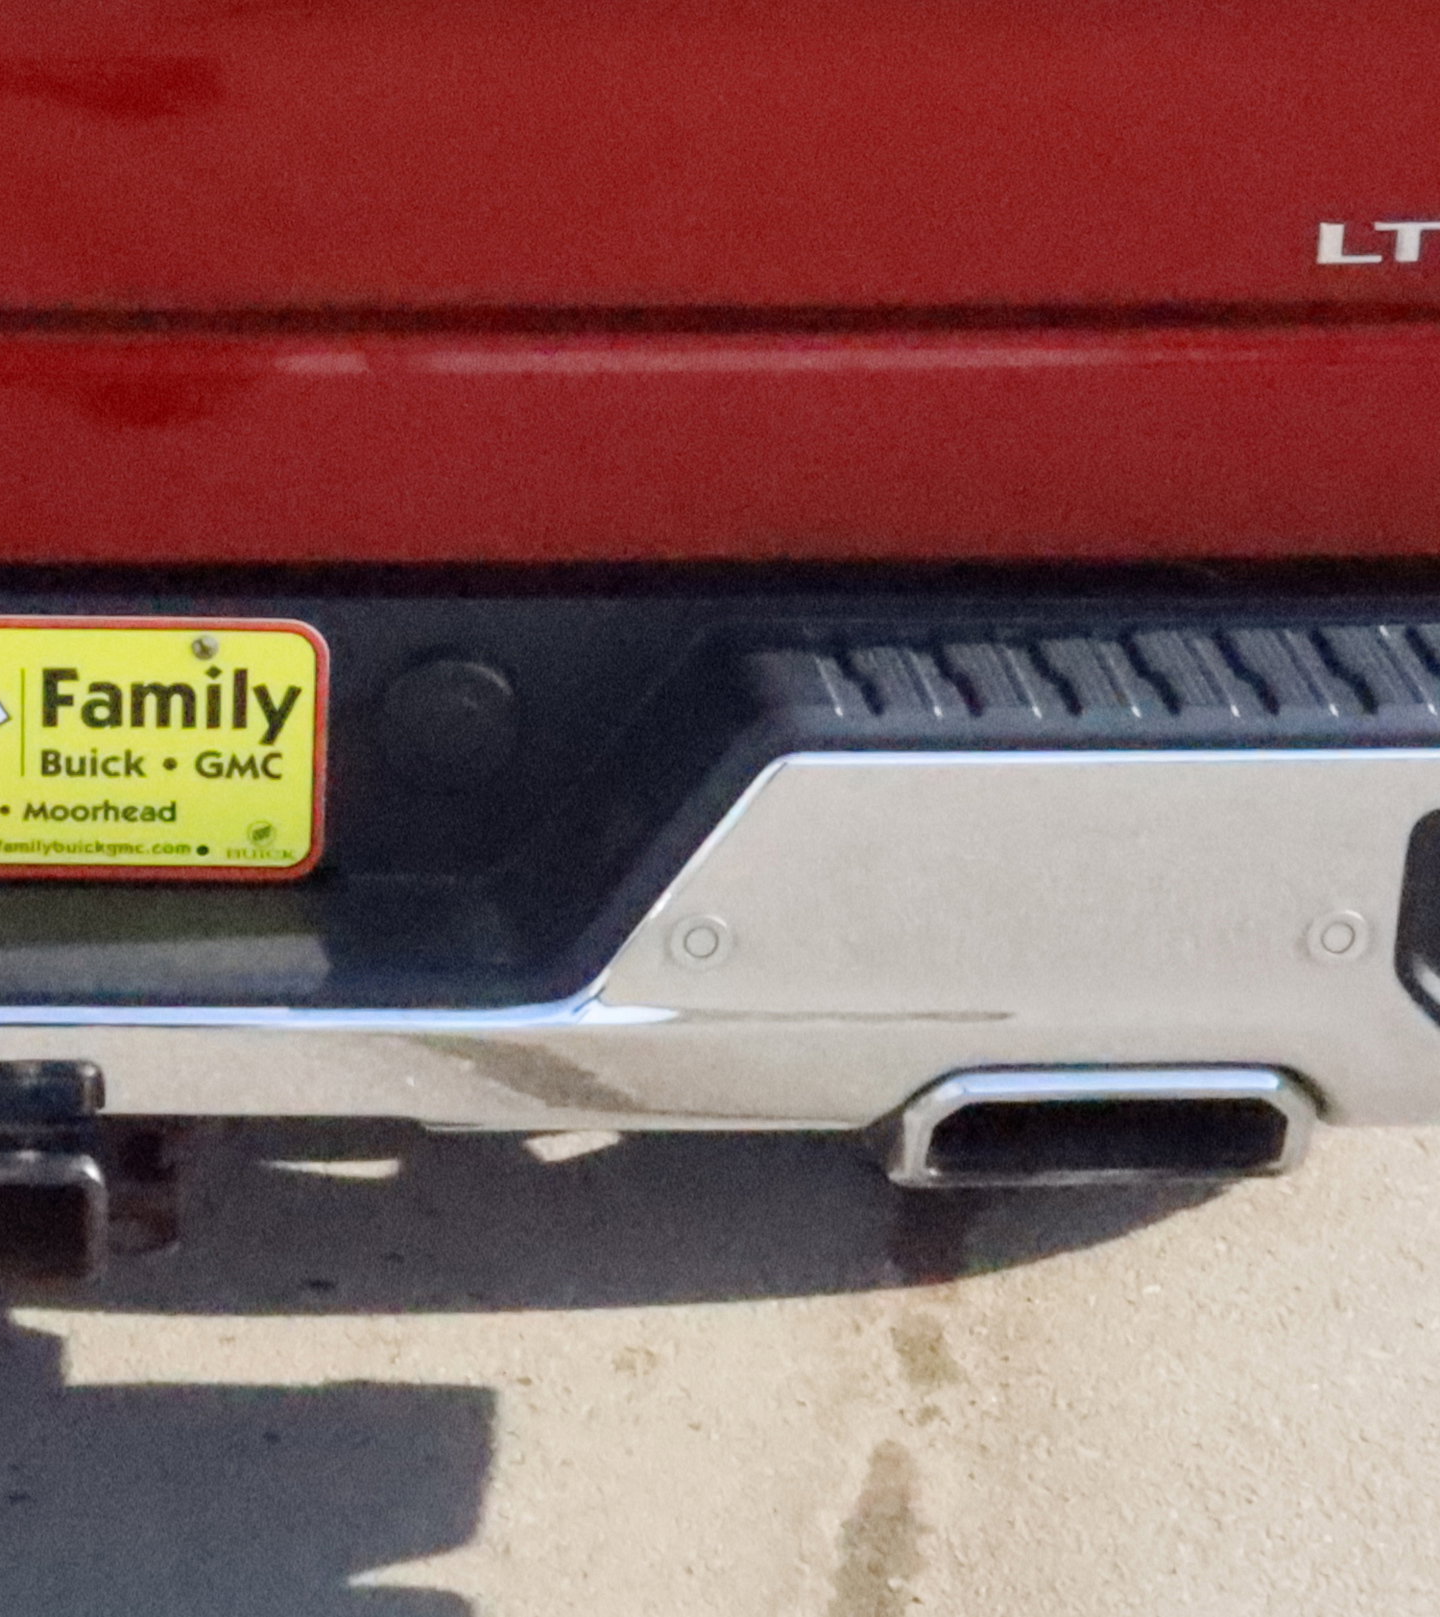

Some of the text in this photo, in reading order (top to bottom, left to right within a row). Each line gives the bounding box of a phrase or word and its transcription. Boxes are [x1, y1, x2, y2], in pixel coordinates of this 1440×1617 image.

[41, 665, 303, 746] Family
[40, 747, 283, 780] Buick GMC
[22, 800, 178, 823] Moorhead
